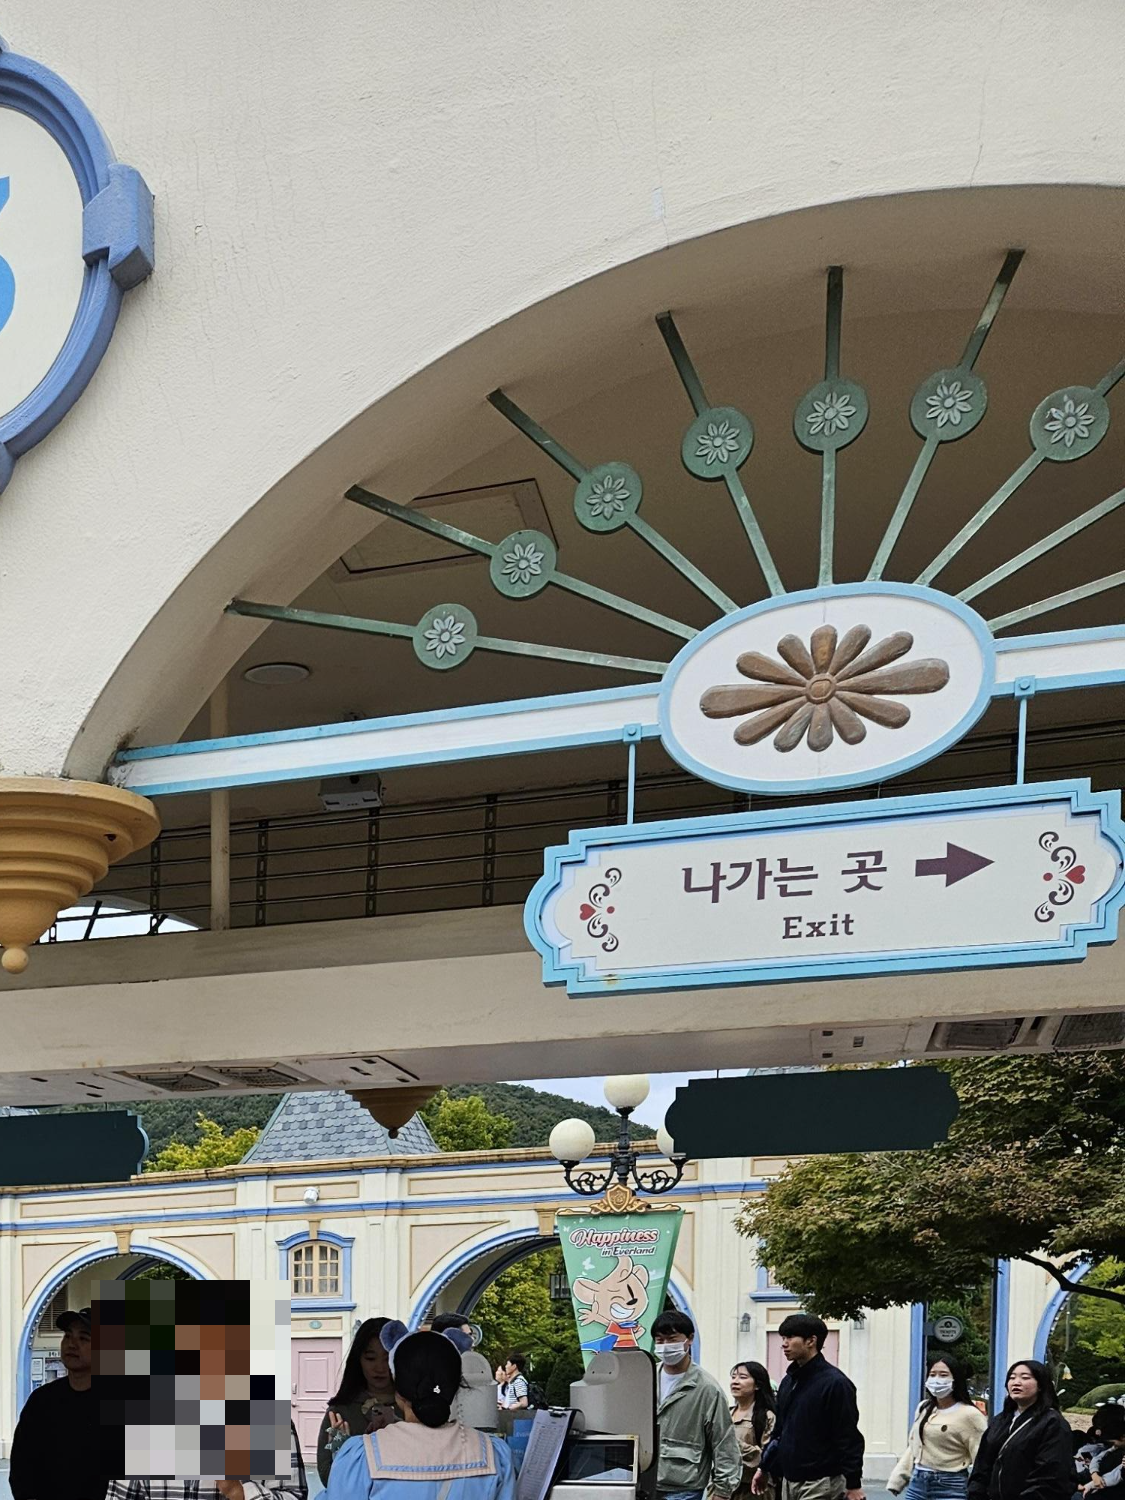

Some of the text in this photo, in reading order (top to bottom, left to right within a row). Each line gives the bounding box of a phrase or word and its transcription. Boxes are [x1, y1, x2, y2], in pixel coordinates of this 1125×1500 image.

[681, 850, 887, 904] 나가는 곳
[782, 913, 855, 940] Exit
[570, 1228, 659, 1248] Happiness
[601, 1246, 655, 1256] in Everland
